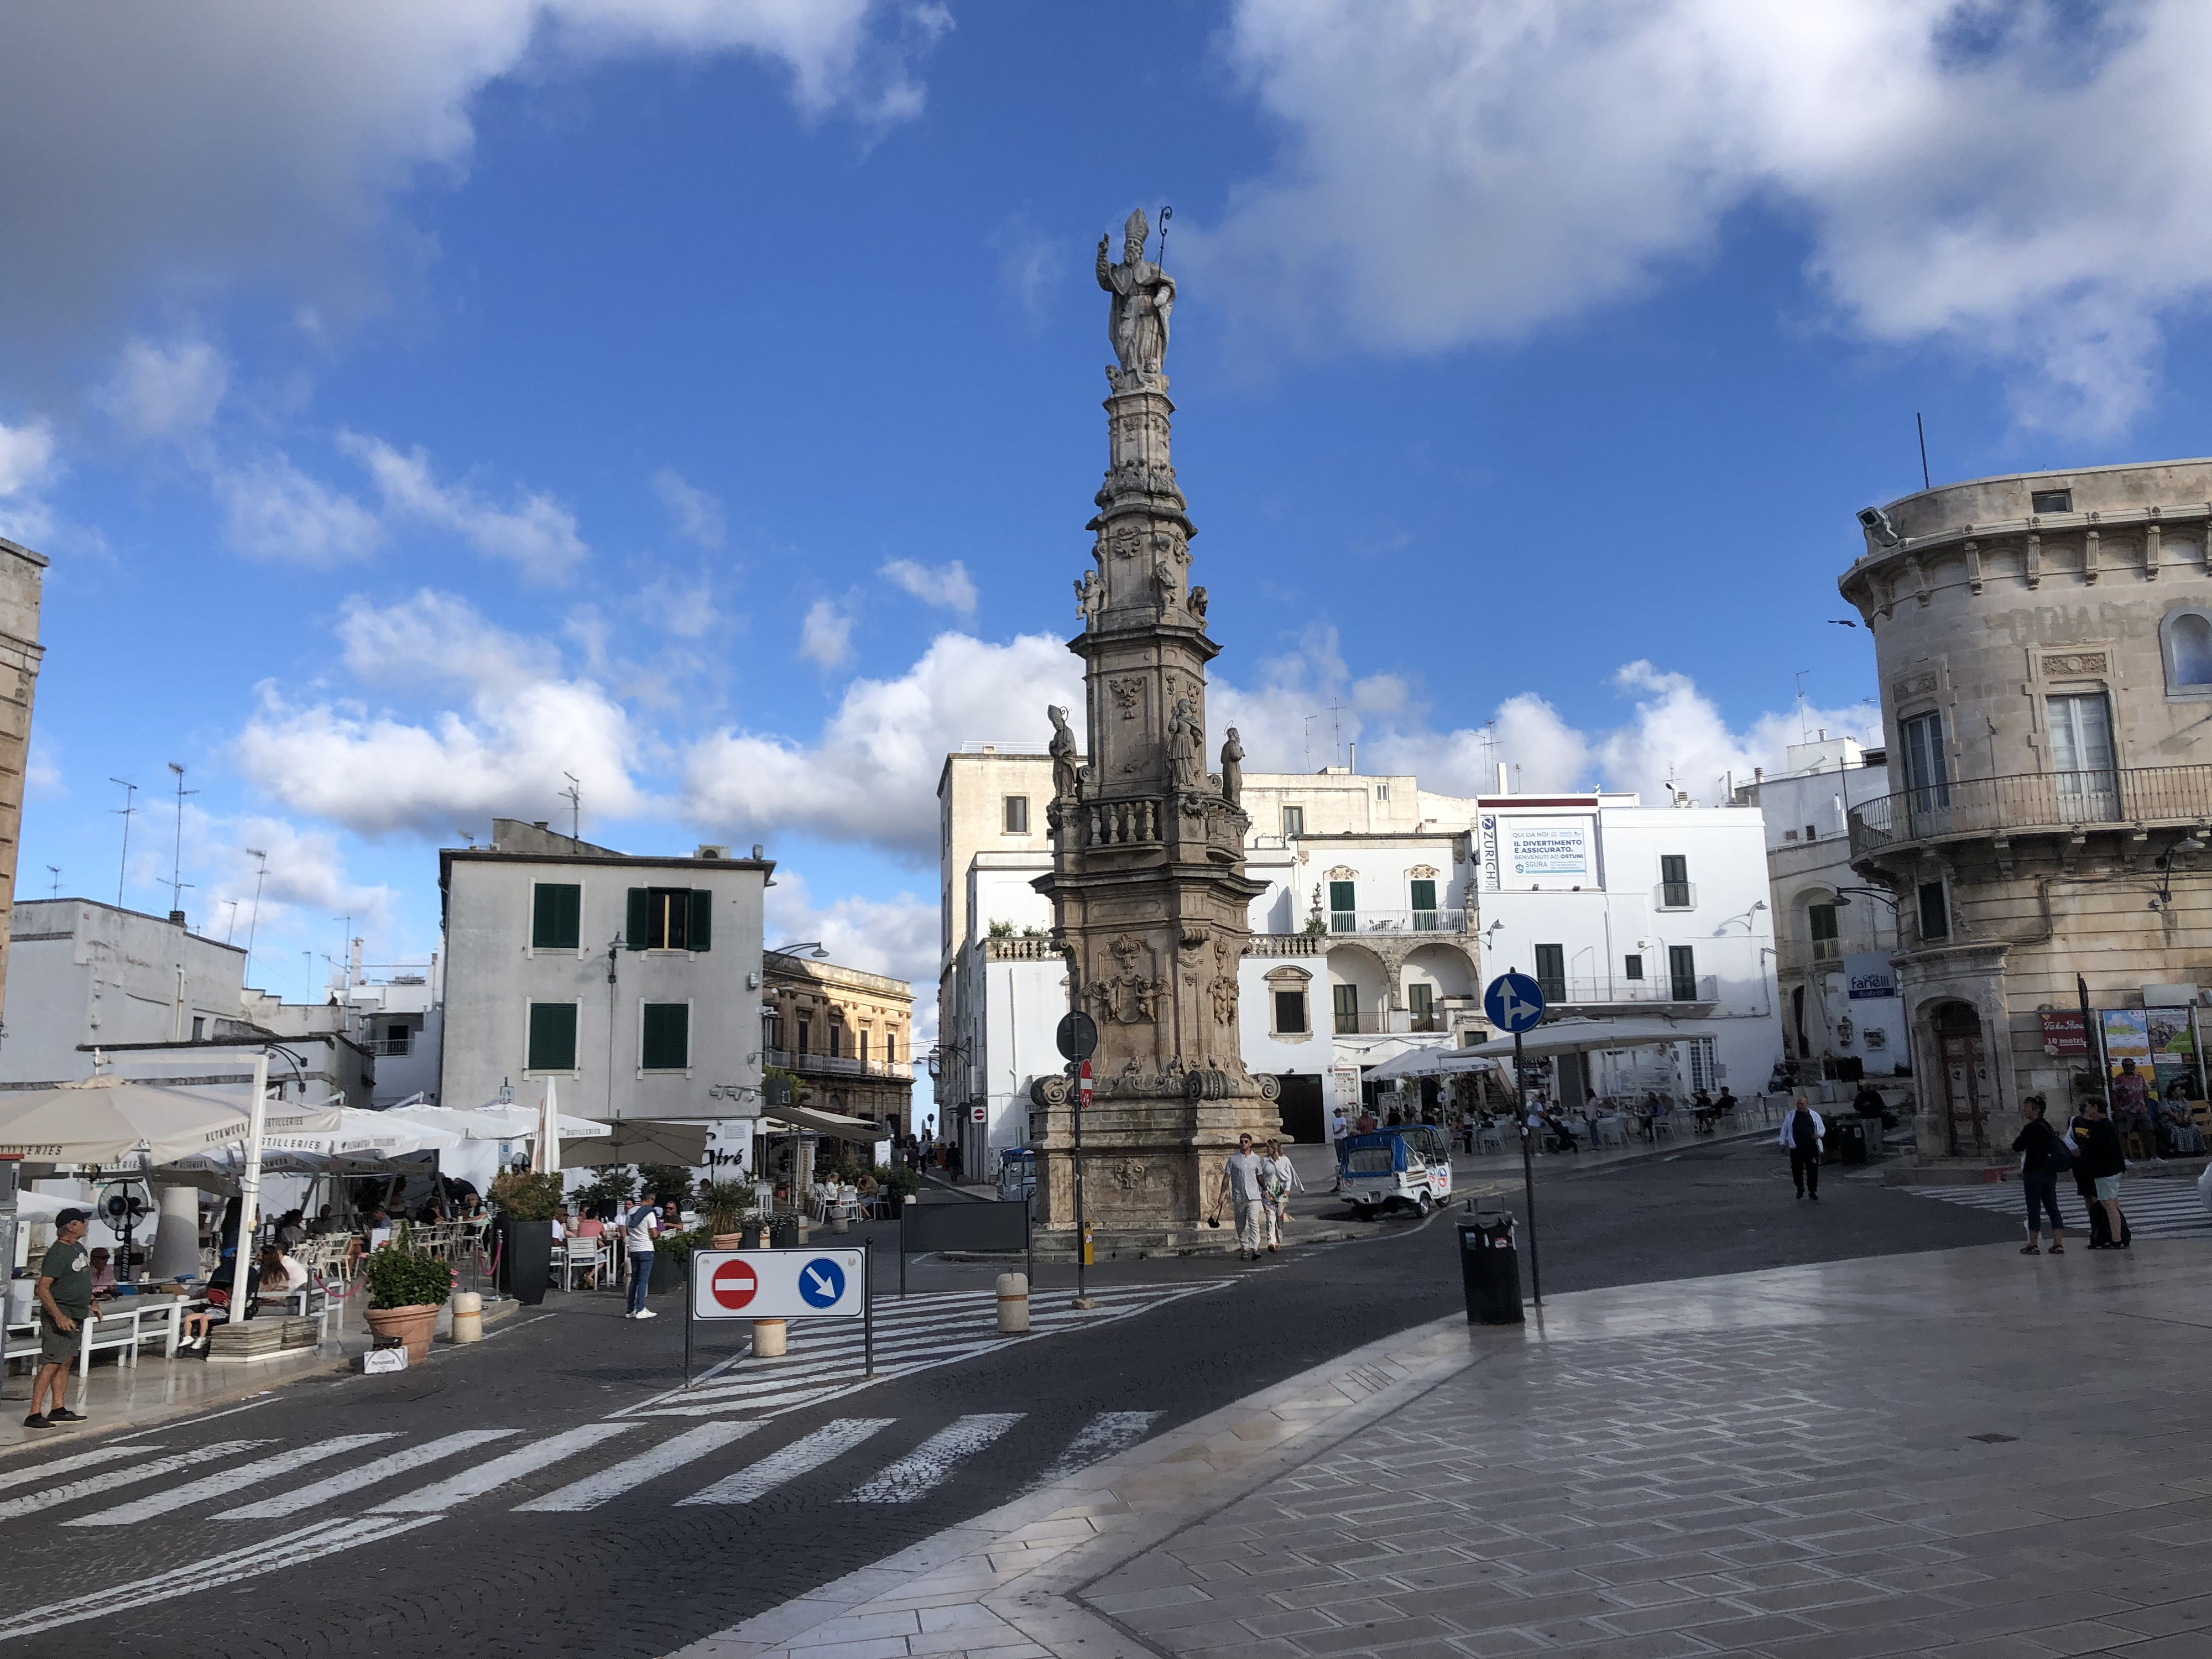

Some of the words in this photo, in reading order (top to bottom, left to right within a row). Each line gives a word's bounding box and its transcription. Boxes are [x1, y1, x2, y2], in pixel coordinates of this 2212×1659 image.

[1484, 832, 1495, 879] ZURICH
[1851, 975, 1889, 989] fanelli
[206, 1123, 245, 1142] ALTAMURA
